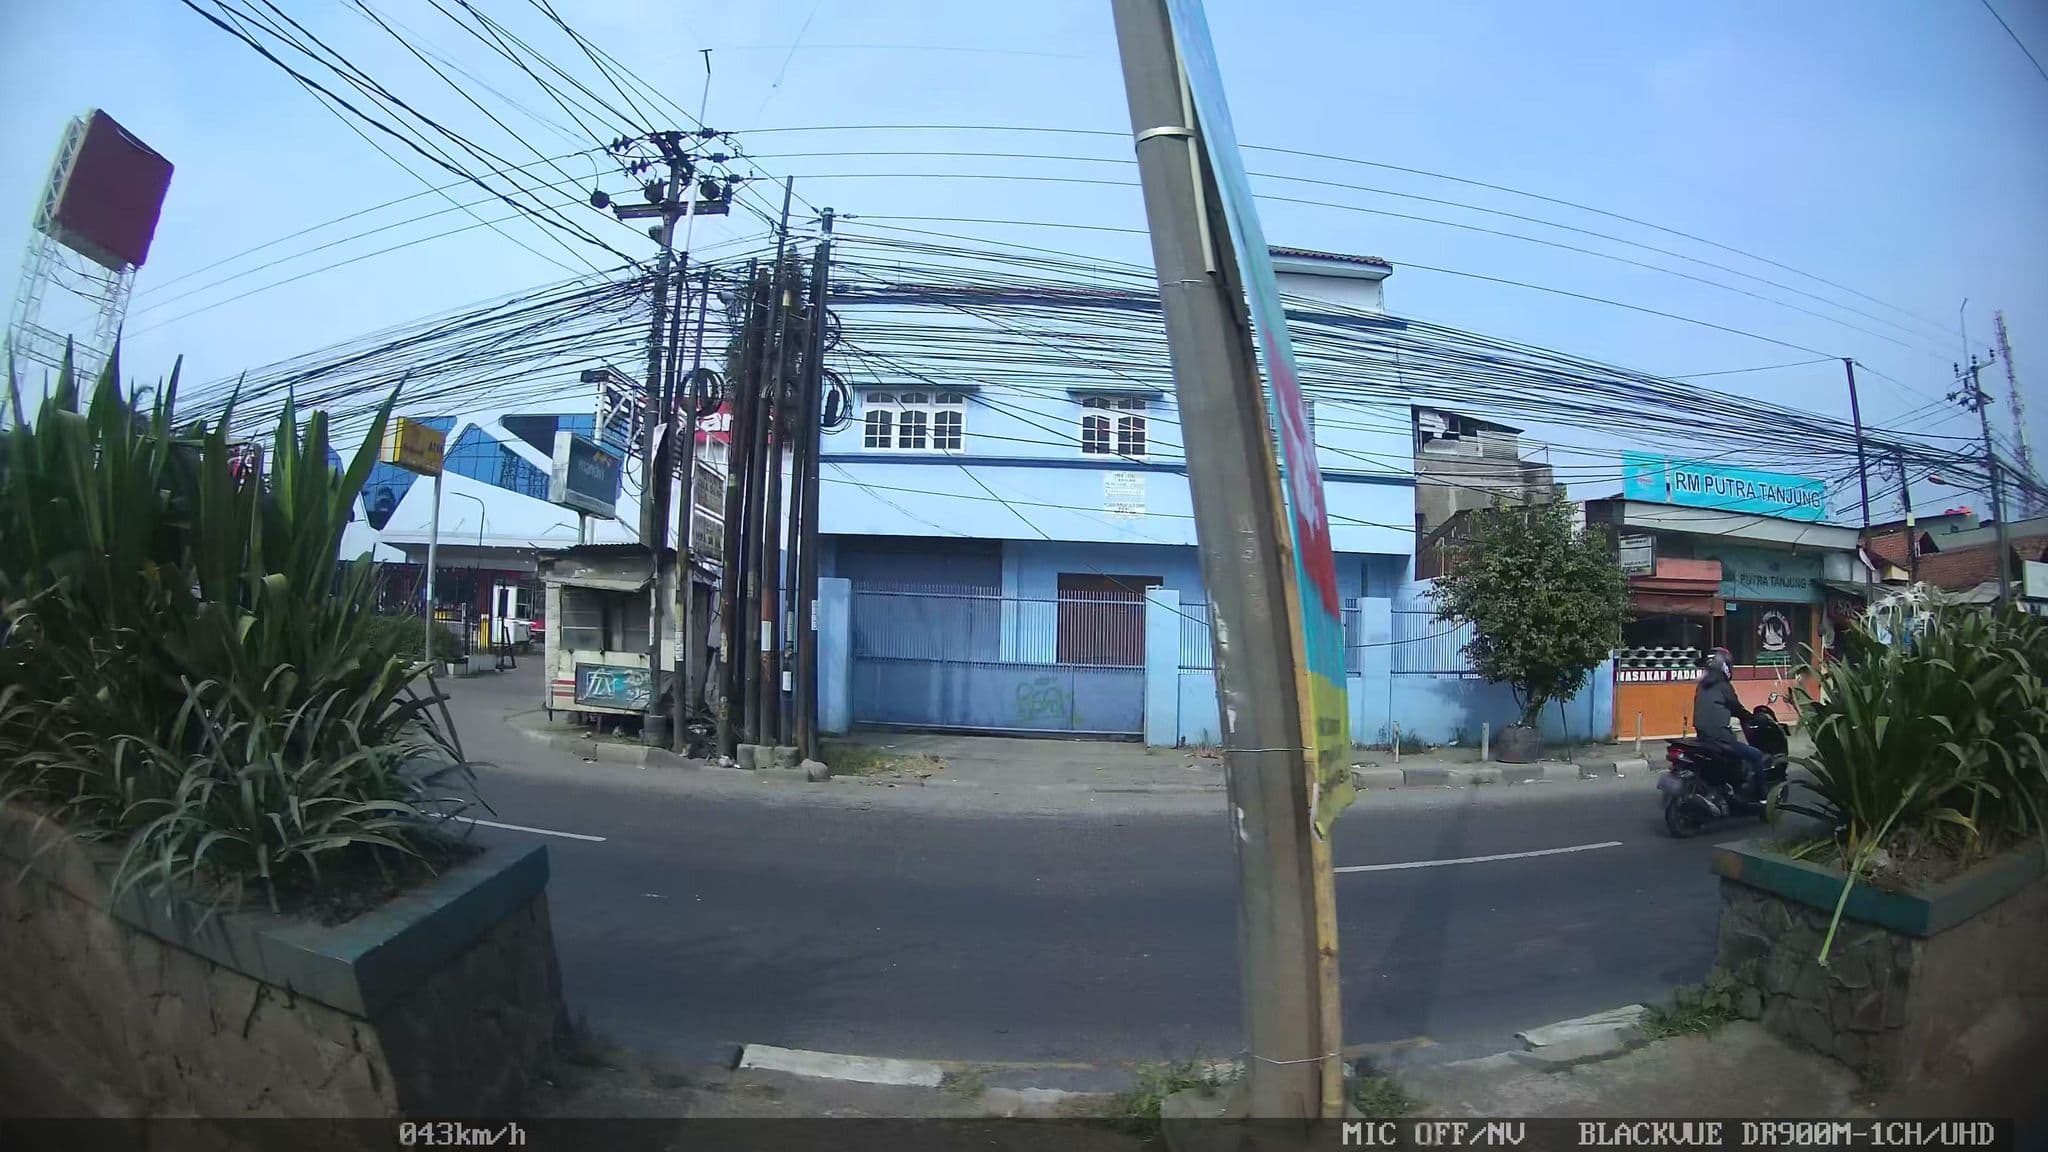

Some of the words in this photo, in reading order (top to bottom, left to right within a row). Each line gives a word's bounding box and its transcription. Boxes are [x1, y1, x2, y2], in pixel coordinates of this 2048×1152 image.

[1675, 471, 1700, 492] RM
[1704, 475, 1755, 499] PUTRA
[1759, 483, 1821, 508] TANJUNG
[1740, 574, 1769, 586] PUTRA
[1770, 575, 1808, 589] TANJUNG
[1616, 669, 1667, 682] MASAKAN
[1670, 668, 1706, 681] PADAN
